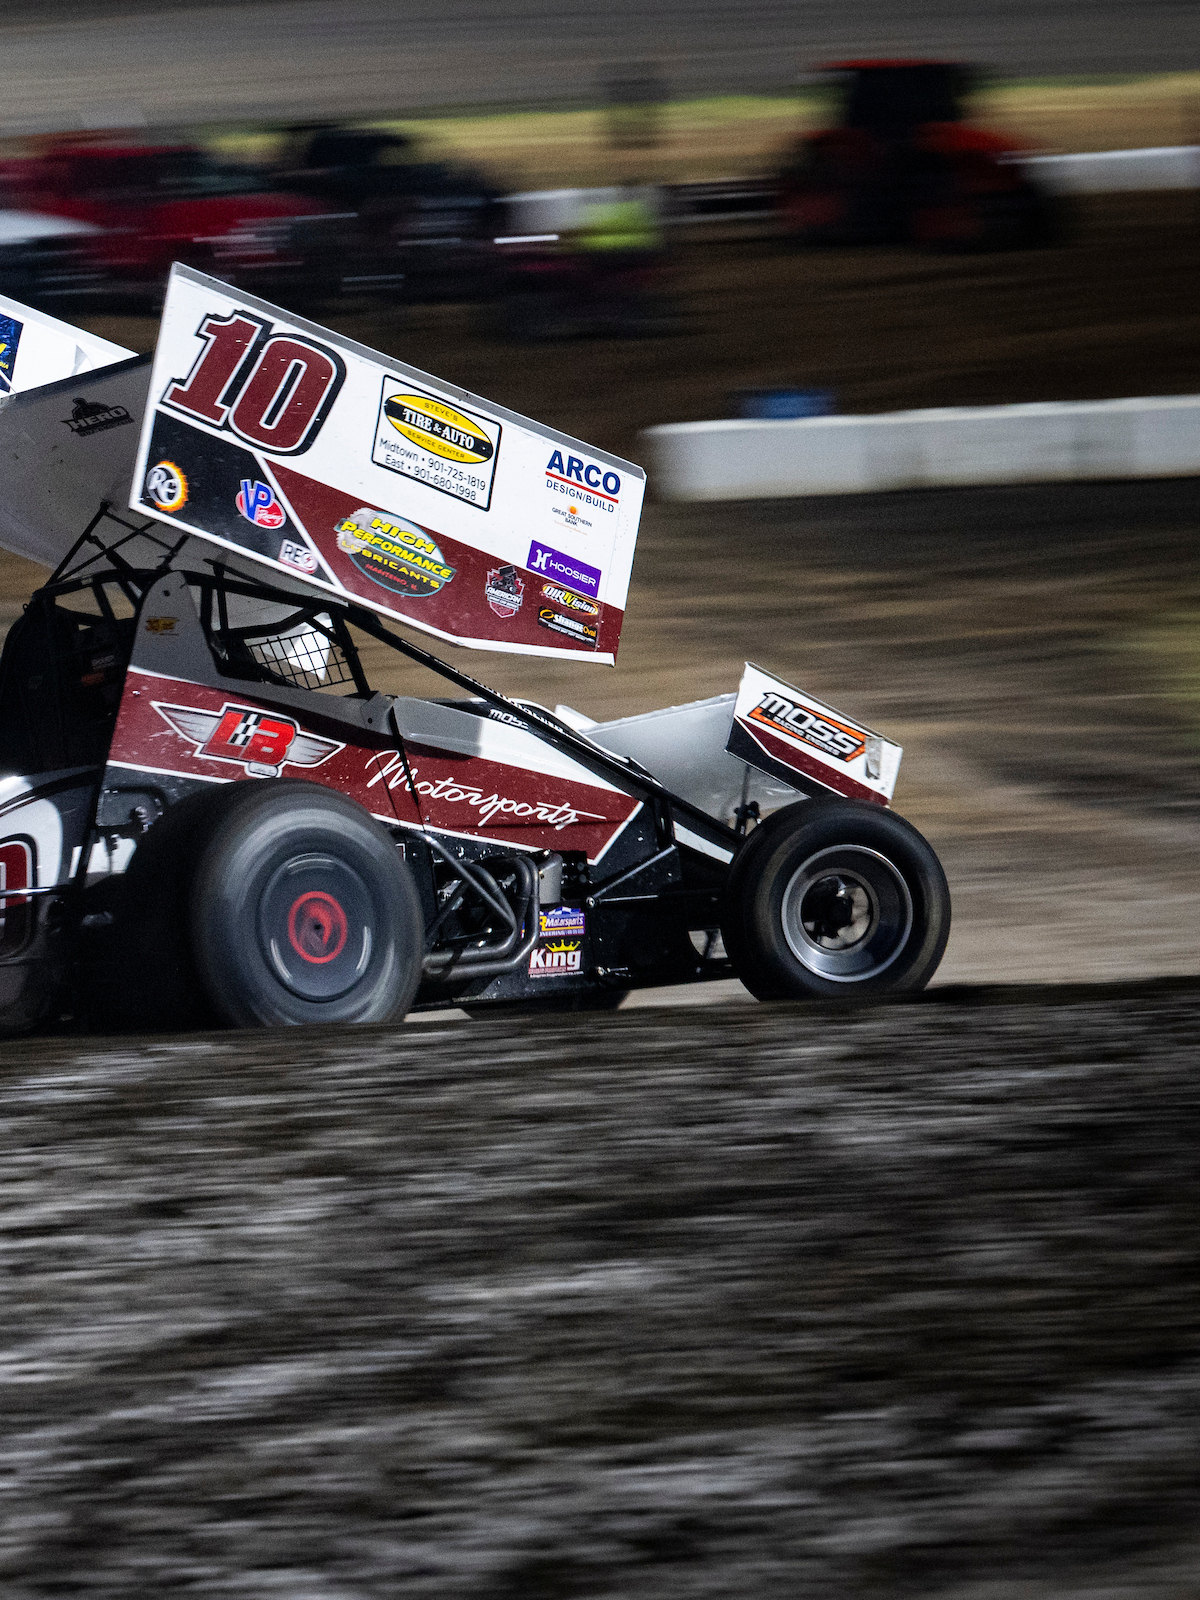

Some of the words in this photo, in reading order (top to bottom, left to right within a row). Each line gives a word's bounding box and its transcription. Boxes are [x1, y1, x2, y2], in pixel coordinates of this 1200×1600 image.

[158, 309, 347, 457] 10
[68, 408, 127, 429] HERO
[402, 408, 433, 432] TIRE
[433, 423, 442, 433] &
[441, 425, 475, 450] AUTO
[424, 402, 459, 422] STEVE'S
[379, 437, 419, 463] Midtown
[427, 457, 487, 491] 901-725-1819
[406, 429, 436, 448] SERVICE
[437, 444, 465, 459] CENTER
[385, 454, 405, 470] East
[413, 465, 477, 501] 901-680-1998
[546, 449, 621, 495] ARCO
[546, 479, 615, 513] DESIGN/BUILD
[340, 521, 453, 579] PERFORMANCE
[371, 518, 436, 554] HIGH
[341, 540, 440, 589] LUBRICANTS
[549, 559, 597, 587] HOOSIER
[487, 586, 521, 605] AMERICAN
[758, 692, 863, 755] MOSS
[364, 749, 607, 831] Motorsports
[530, 948, 581, 971] King
